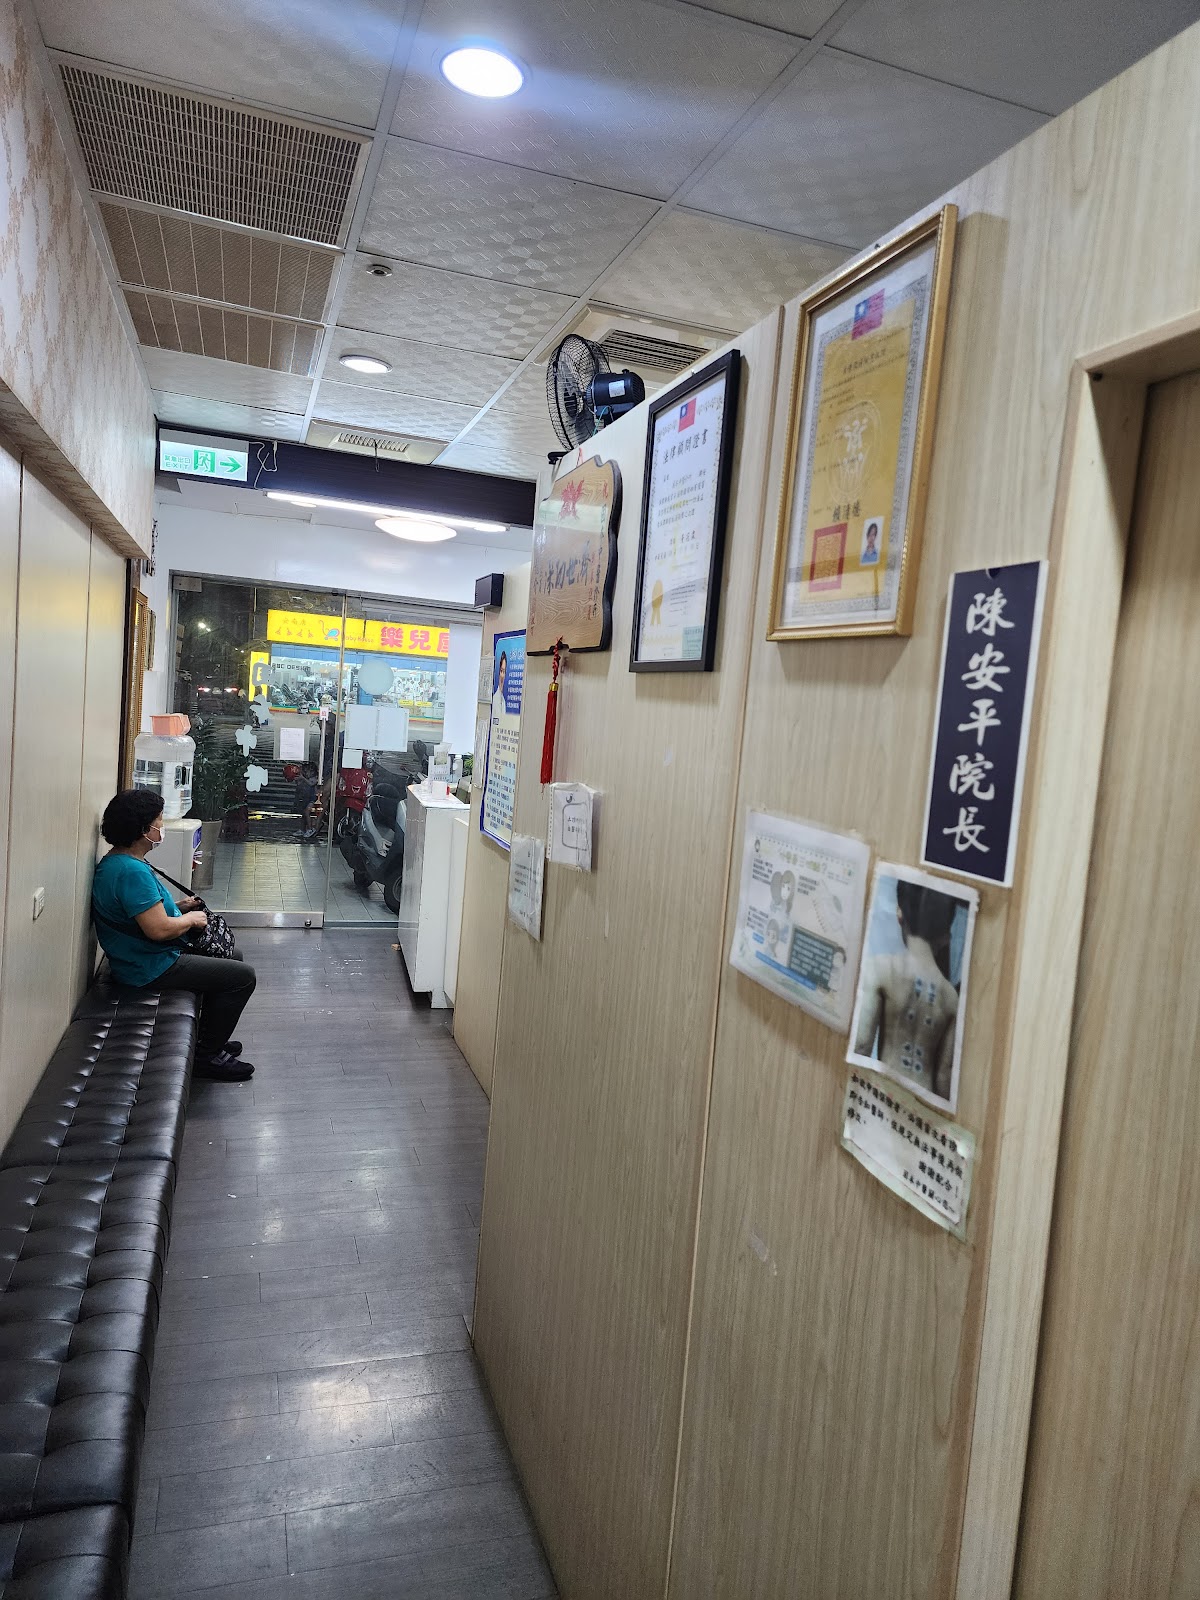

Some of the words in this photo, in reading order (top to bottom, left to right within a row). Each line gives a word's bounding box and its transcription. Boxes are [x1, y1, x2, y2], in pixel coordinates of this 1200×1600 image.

[164, 454, 191, 464] 緊急出口
[165, 461, 189, 470] EXIT
[943, 587, 1015, 853] 陳安平院長
